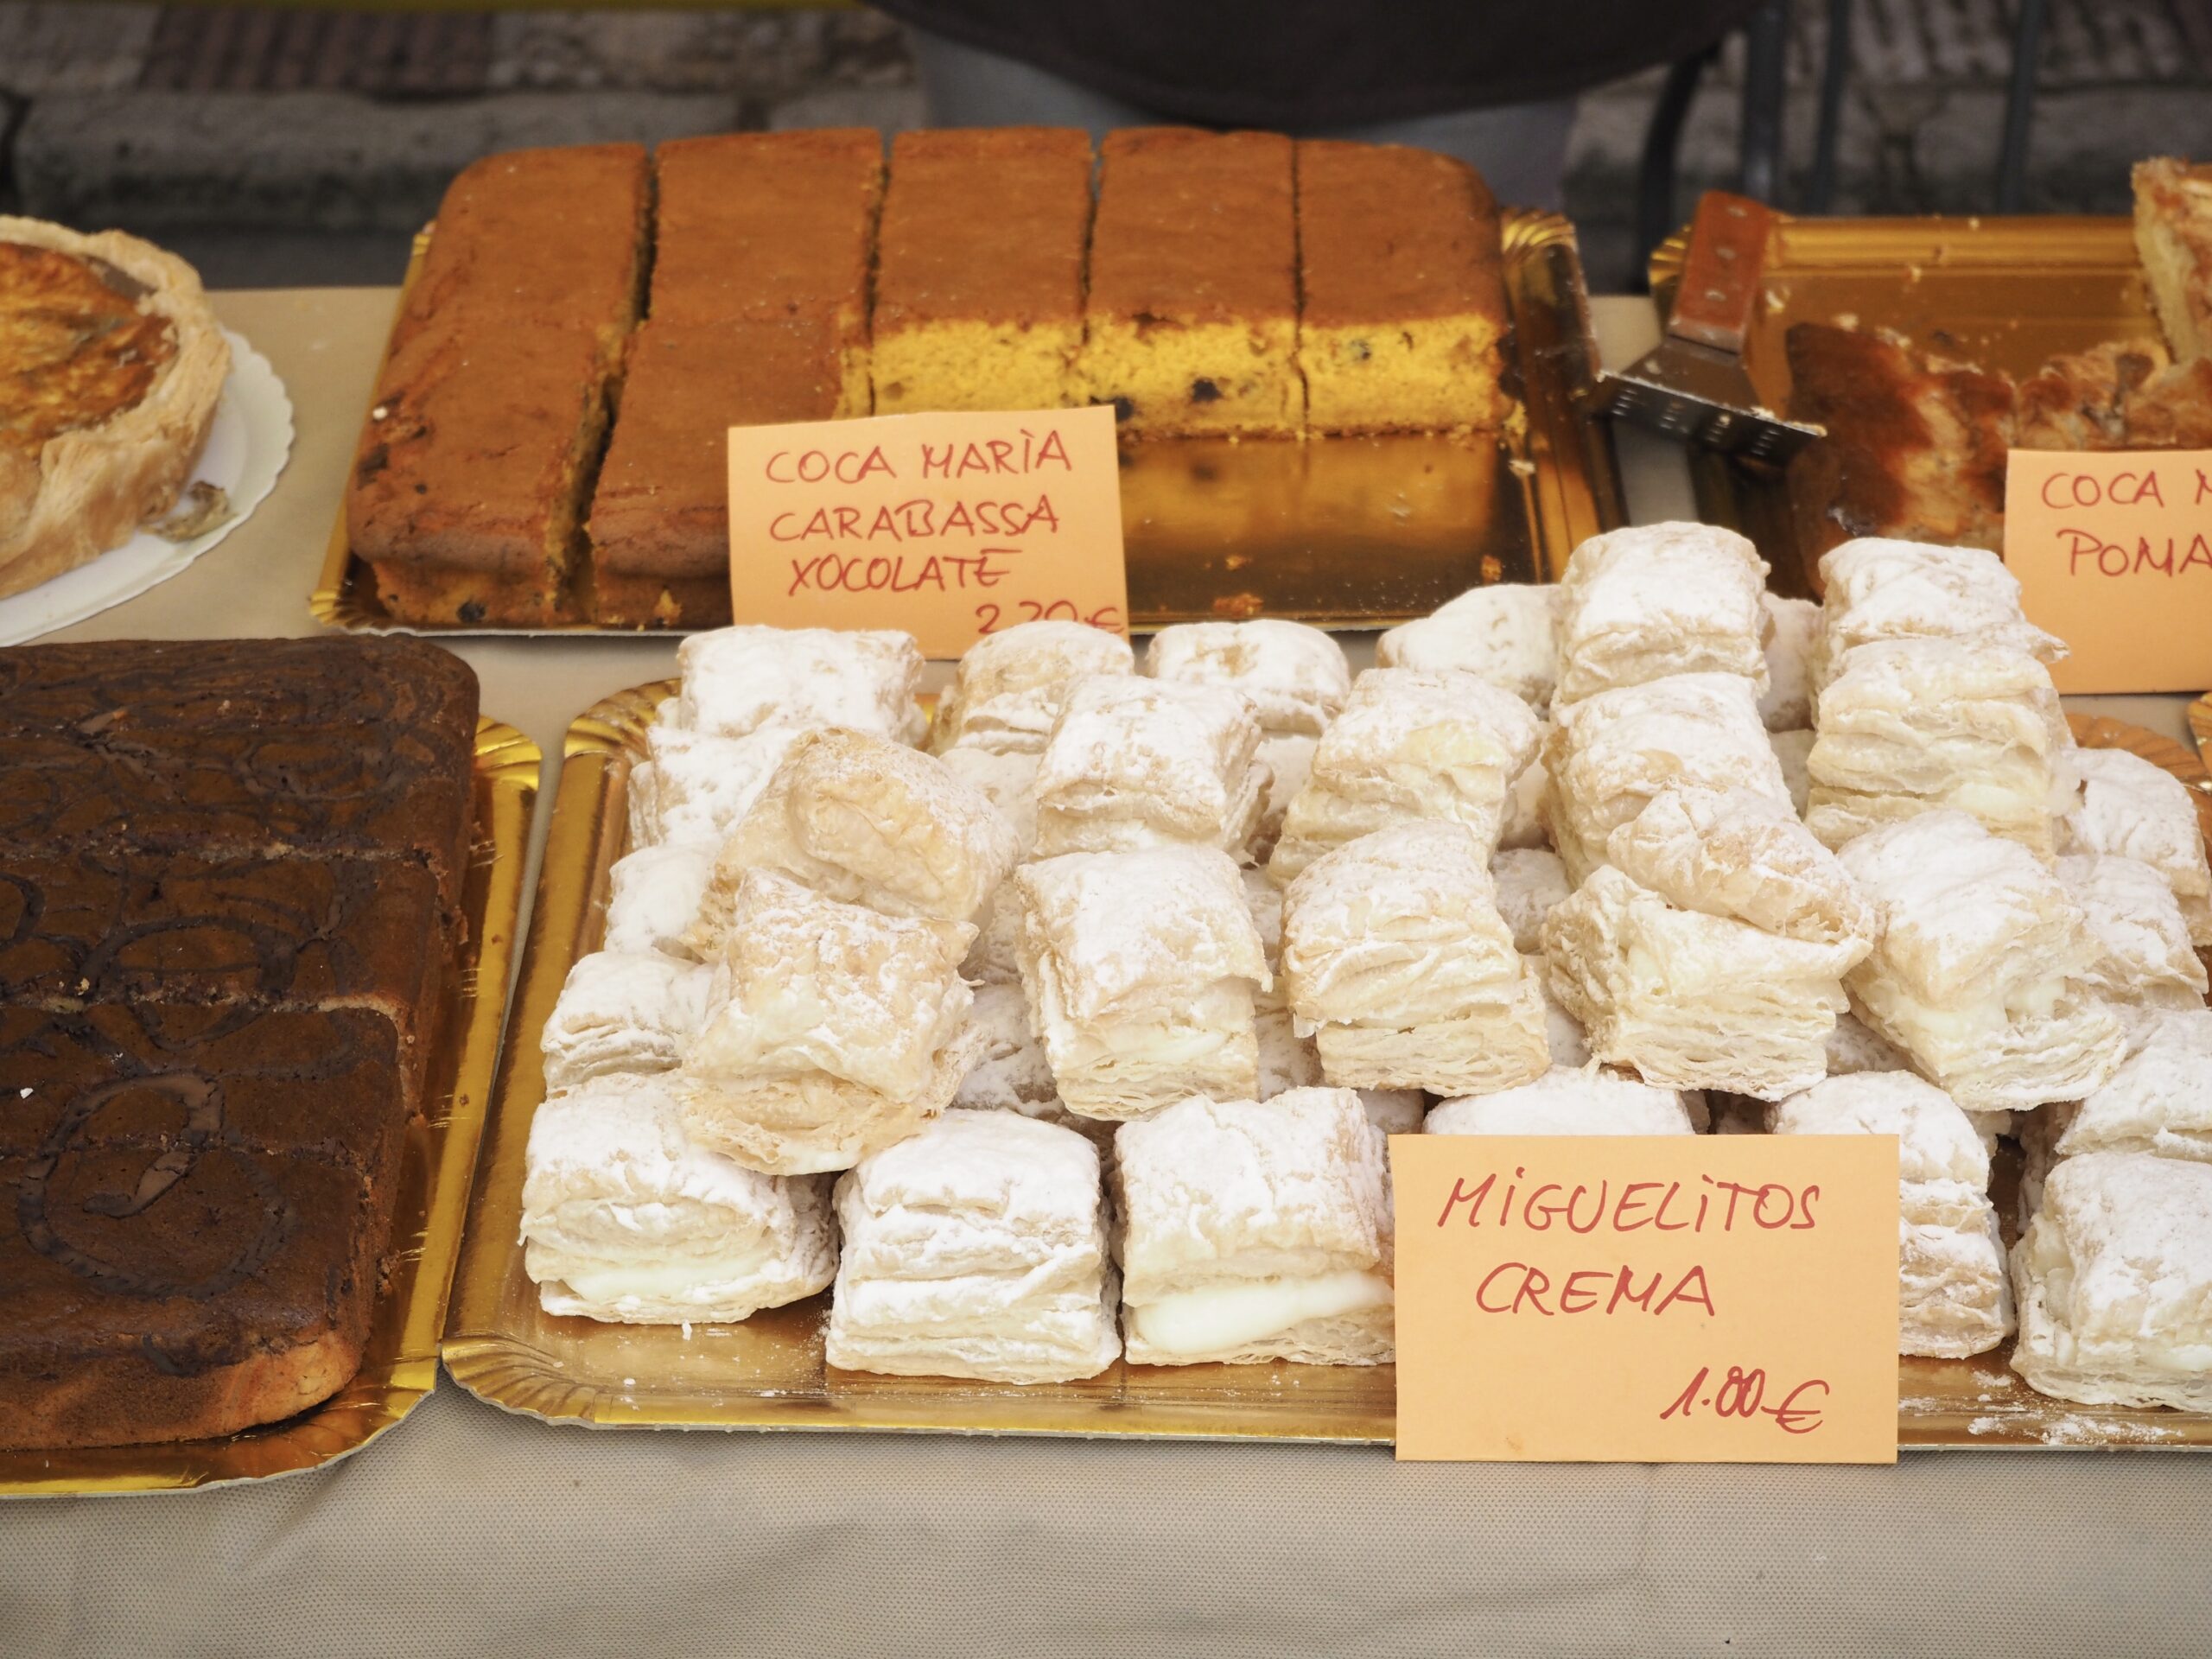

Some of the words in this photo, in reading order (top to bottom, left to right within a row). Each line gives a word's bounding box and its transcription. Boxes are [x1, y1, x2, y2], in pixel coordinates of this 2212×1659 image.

[765, 445, 897, 484] COCA
[2041, 470, 2165, 509] COCA
[769, 493, 1060, 542] CARABASSA
[788, 547, 1023, 596] XOCOLATE
[1476, 1262, 1715, 1317] CREMA
[1660, 1365, 1830, 1434] 1.00€
